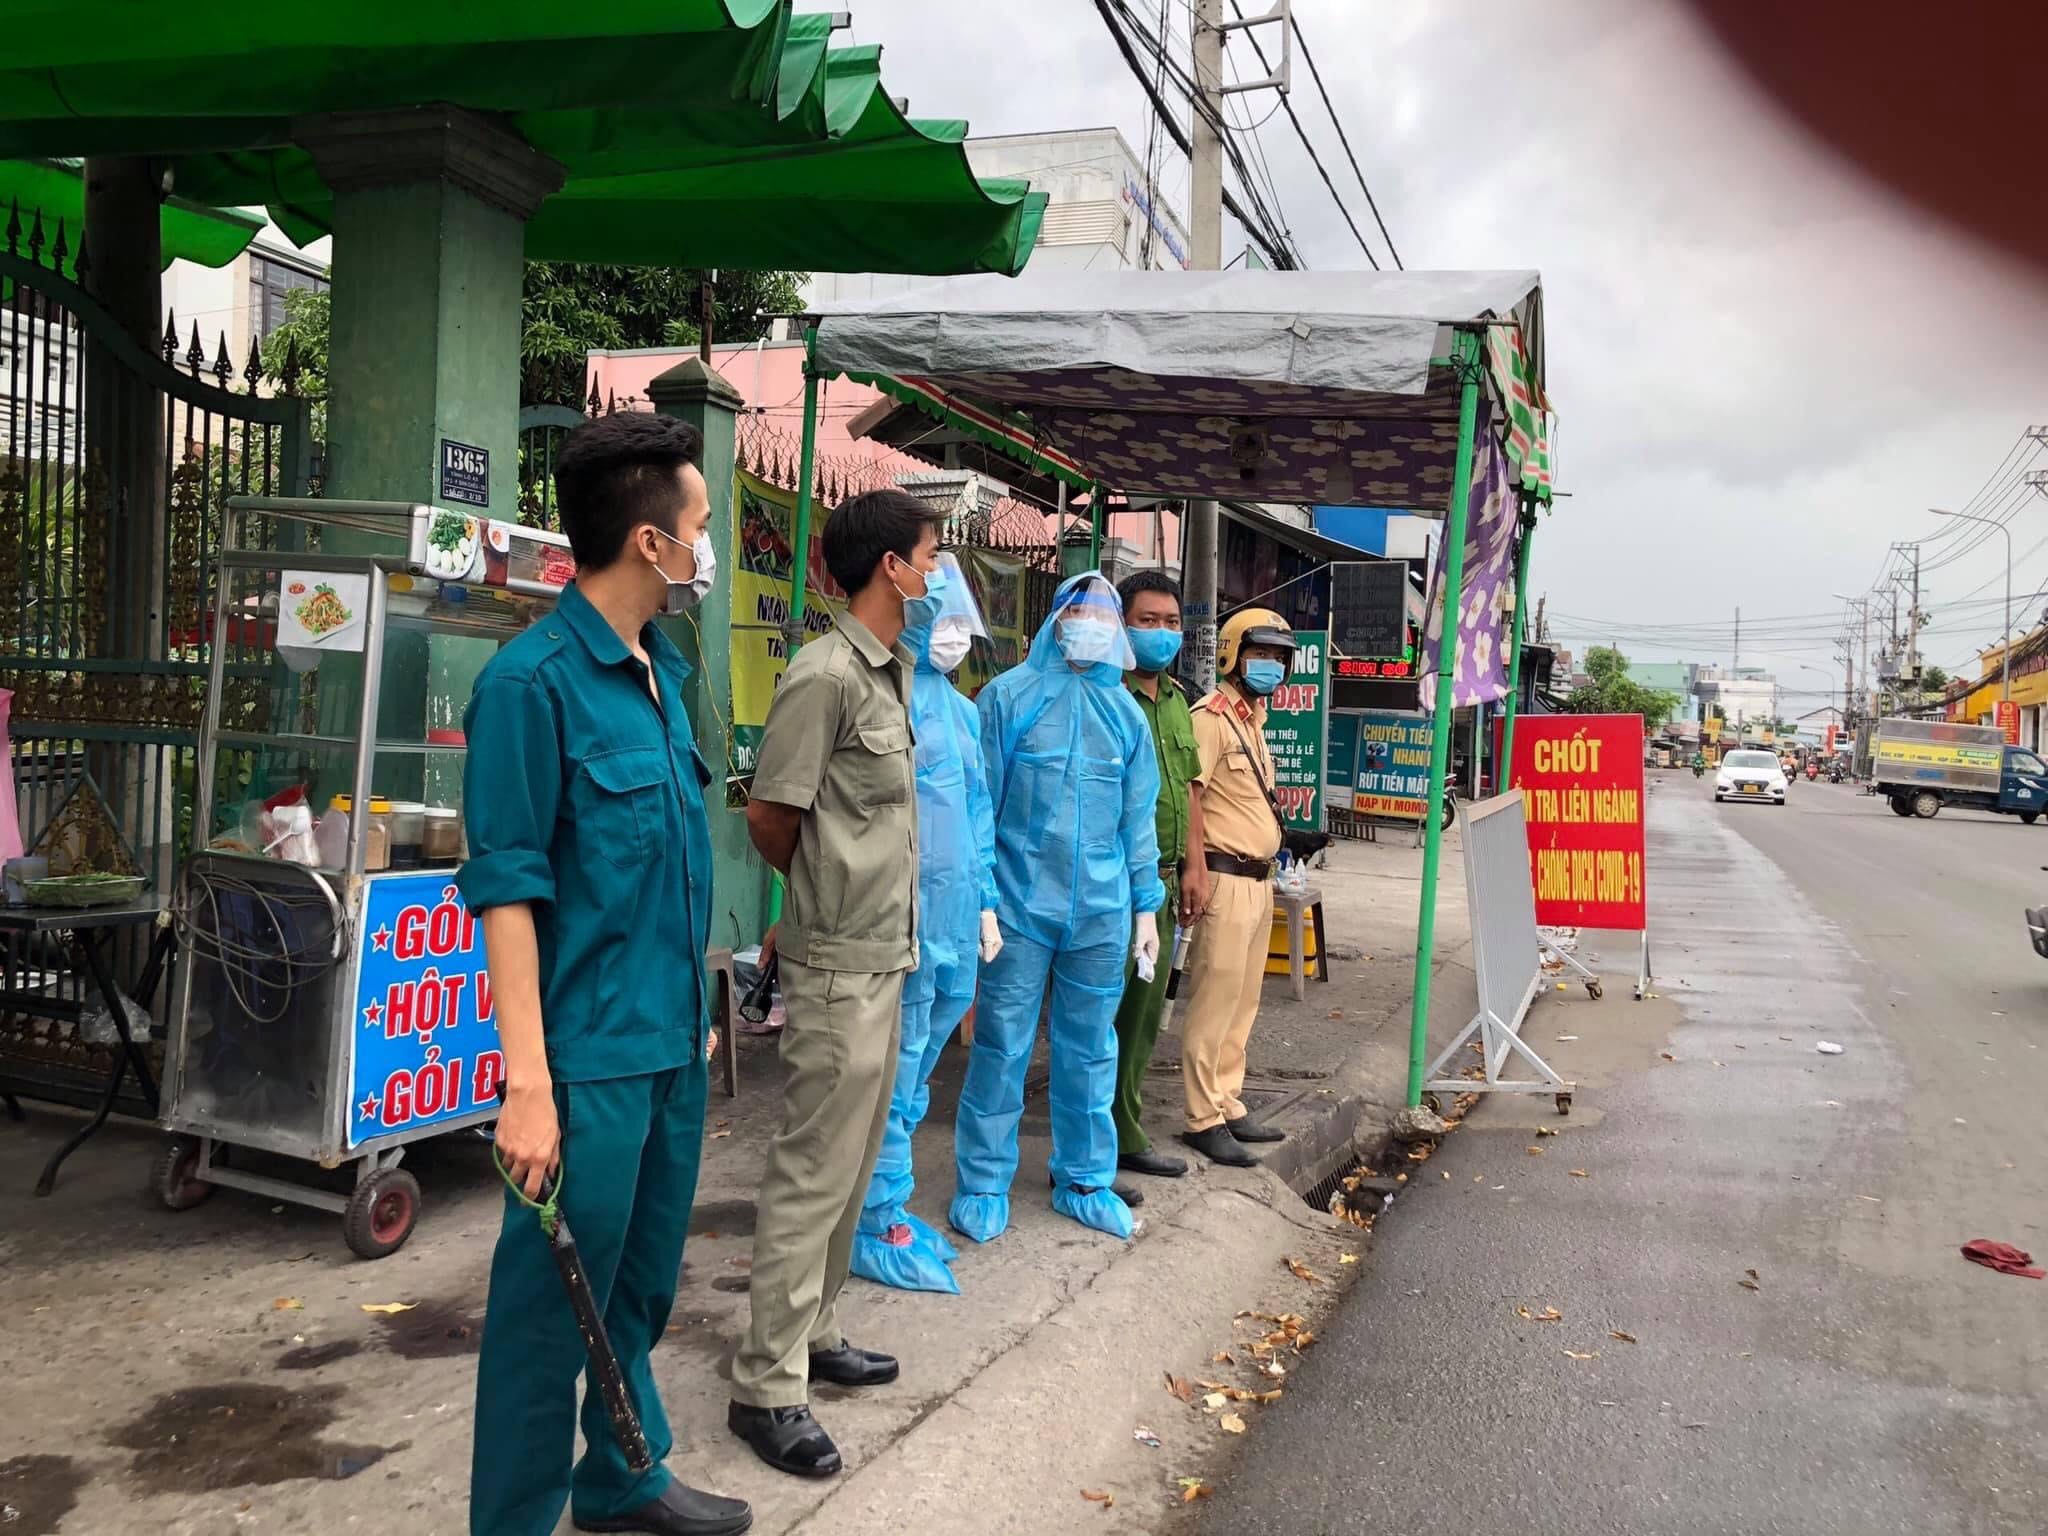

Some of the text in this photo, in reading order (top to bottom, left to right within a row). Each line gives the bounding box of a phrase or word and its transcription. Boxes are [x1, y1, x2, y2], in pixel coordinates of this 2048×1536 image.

[446, 446, 485, 476] 1365
[1294, 644, 1320, 675] NG
[1338, 661, 1377, 674] SIM
[1272, 683, 1318, 715] ĐẠT
[1363, 720, 1406, 743] CHUYỂN
[1296, 745, 1303, 755] &
[1534, 727, 1602, 773] CHỐT
[1358, 769, 1379, 790] RÚT
[1406, 775, 1430, 798] MẶT
[1276, 786, 1317, 820] PPY
[1535, 789, 1559, 823] TRA
[1562, 782, 1590, 823] LIÊN
[1593, 782, 1638, 824] NGÀNH
[1537, 831, 1570, 901] CHỐNG
[1572, 849, 1595, 913] DỊCH
[1597, 850, 1640, 904] COVID-19
[393, 885, 475, 961] GỎI
[384, 967, 467, 1044] HỘT
[381, 1046, 463, 1127] GỎI
